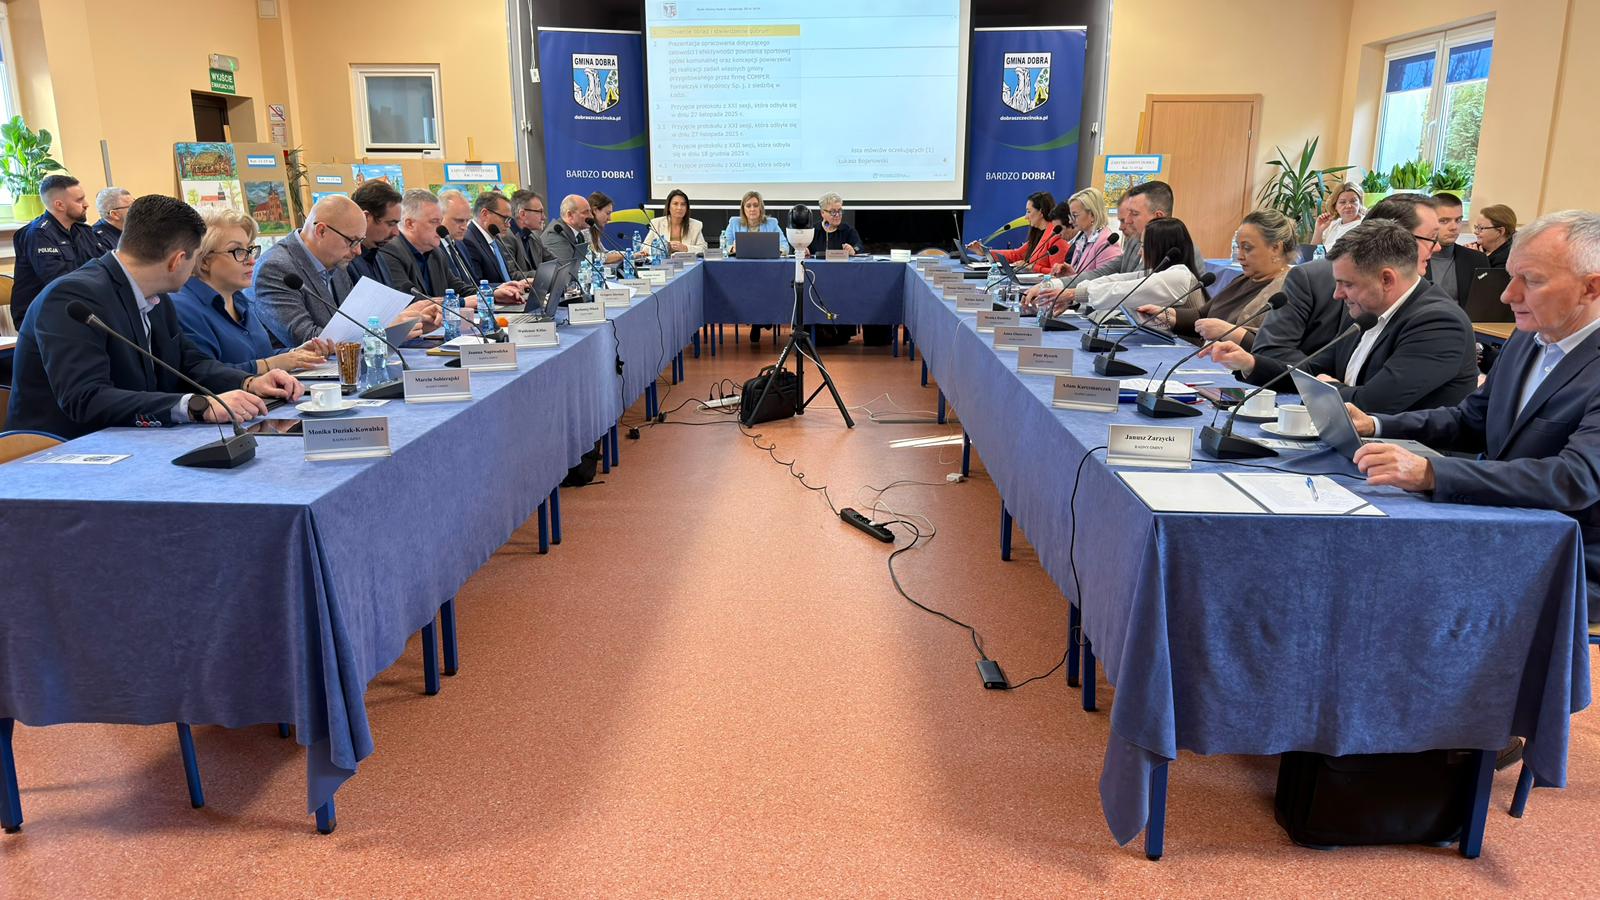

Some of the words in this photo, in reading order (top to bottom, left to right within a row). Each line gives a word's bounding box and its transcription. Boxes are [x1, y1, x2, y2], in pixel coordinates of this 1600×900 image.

[574, 58, 594, 66] GMINA
[595, 58, 616, 66] DOBRA
[211, 72, 232, 82] WYJŚCIE
[566, 170, 600, 178] BARDZO
[602, 170, 634, 179] DOBRA!
[986, 172, 1020, 180] BARDZO
[1022, 171, 1055, 180] DOBRA!
